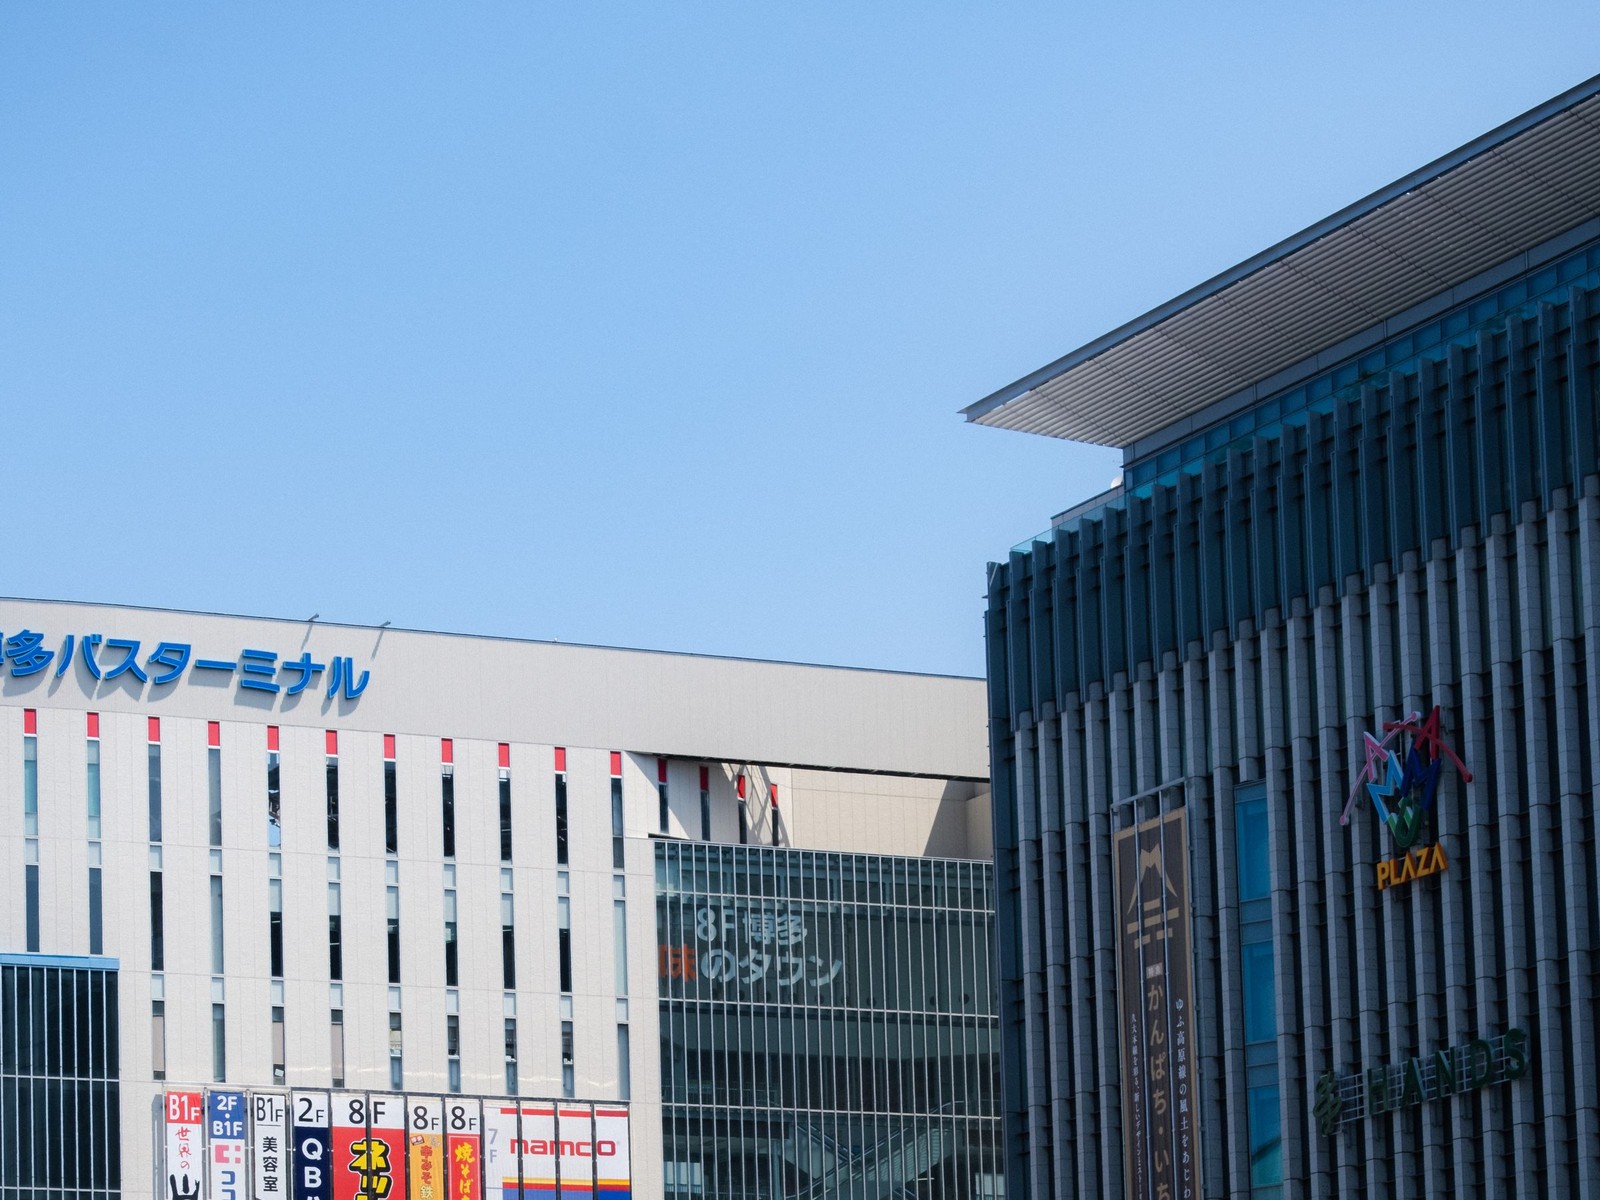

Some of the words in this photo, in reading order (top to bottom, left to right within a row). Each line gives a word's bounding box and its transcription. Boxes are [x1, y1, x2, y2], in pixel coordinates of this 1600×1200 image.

[0, 629, 370, 700] 多バスターミナル
[1376, 841, 1449, 891] PLAZA
[1367, 1028, 1528, 1116] HANDS
[169, 1094, 200, 1121] B1F
[216, 1095, 238, 1111] 2F
[256, 1097, 284, 1123] B1F
[298, 1097, 325, 1123] 2F
[348, 1099, 387, 1125] 8F
[212, 1120, 243, 1137] B1F
[412, 1105, 440, 1131] 8F
[451, 1105, 478, 1131] 8F
[510, 1138, 617, 1158] namco
[262, 1136, 279, 1193] 美容室
